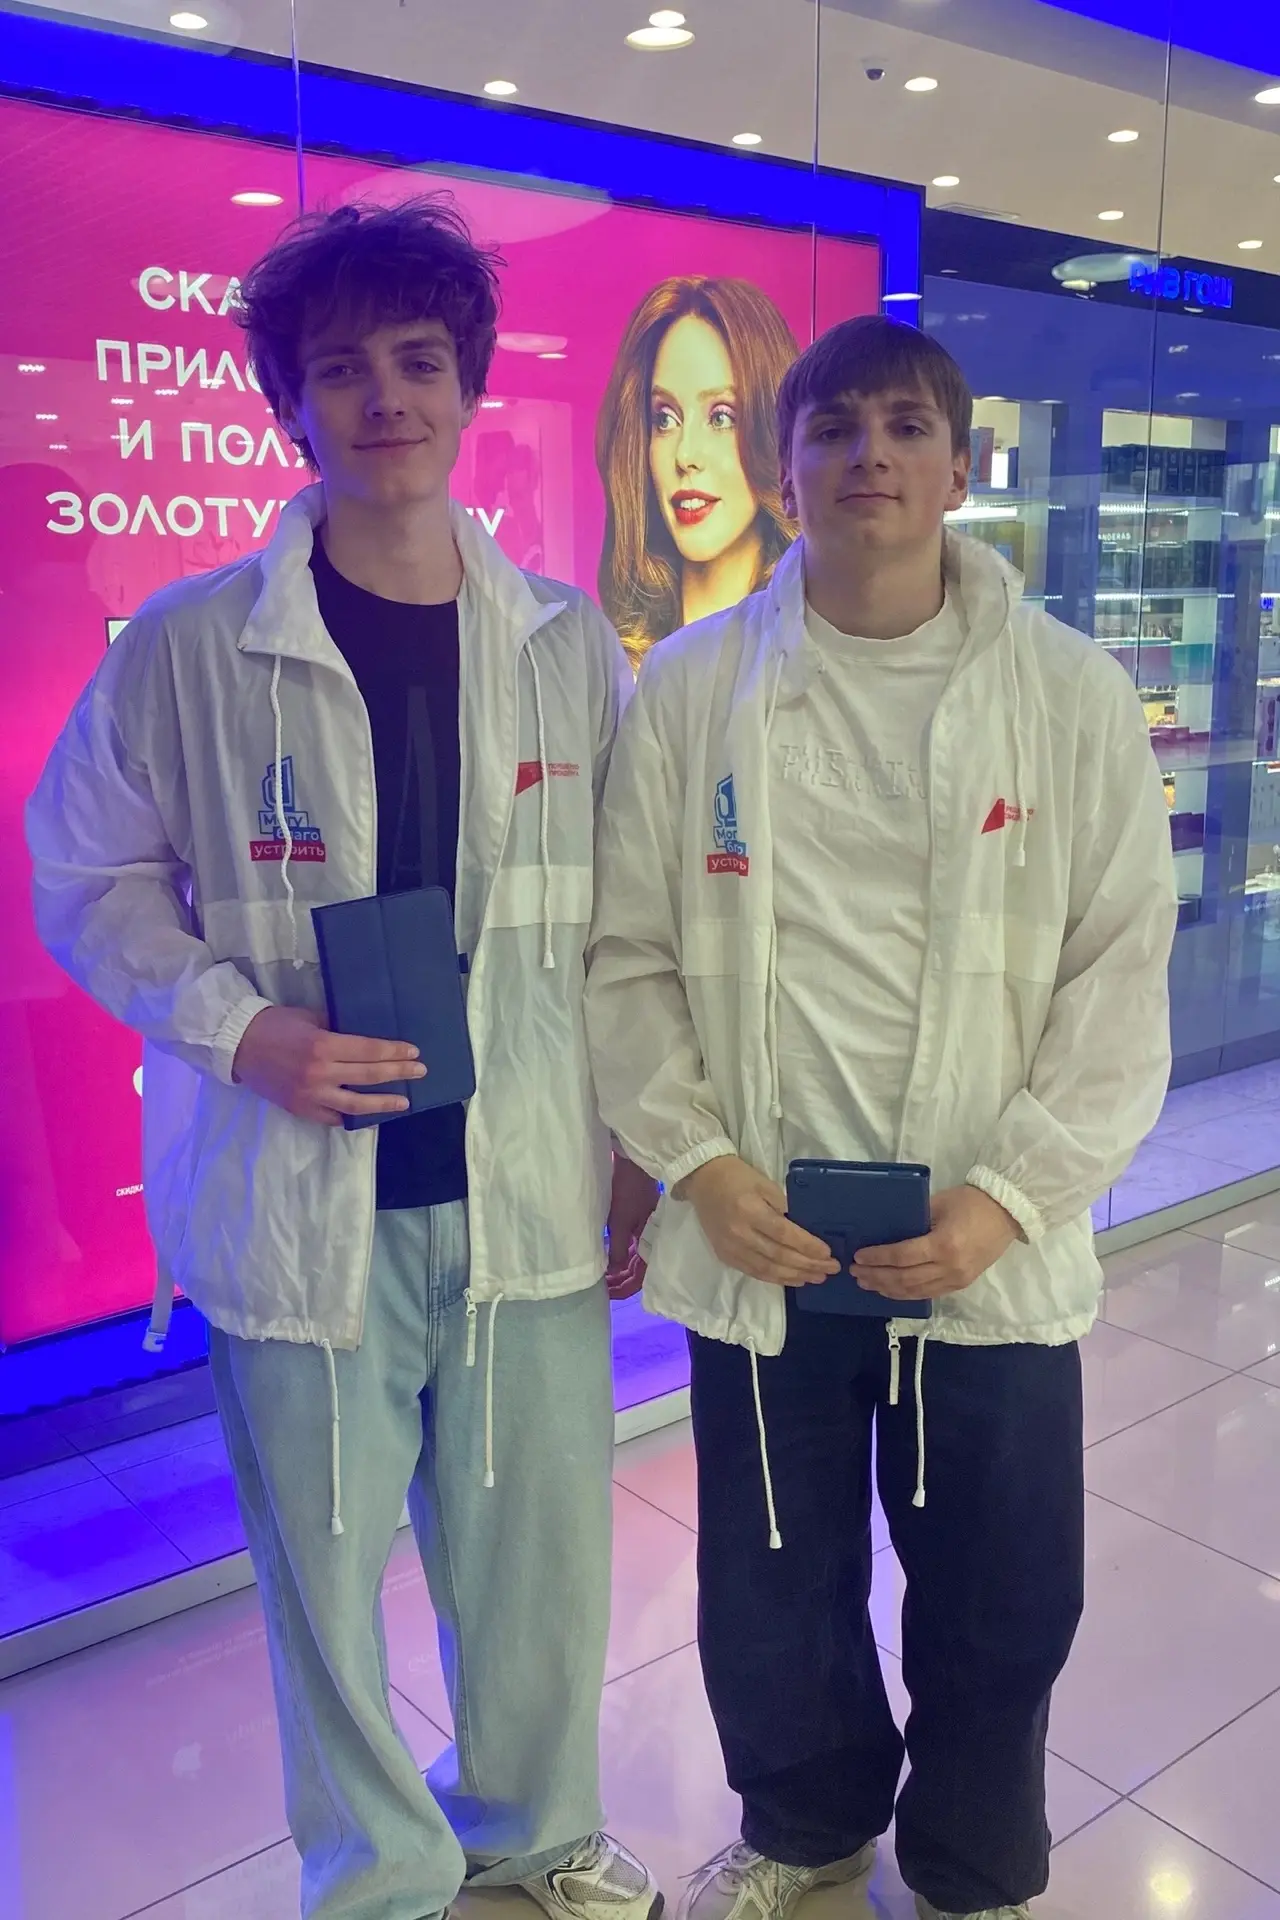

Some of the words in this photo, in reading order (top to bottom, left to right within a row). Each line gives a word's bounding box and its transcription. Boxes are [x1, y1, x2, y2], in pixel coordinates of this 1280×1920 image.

[1183, 270, 1233, 308] ГОШ
[119, 418, 153, 460] И
[181, 422, 305, 469] ПОЛ
[46, 491, 288, 538] ЗОЛОТУ
